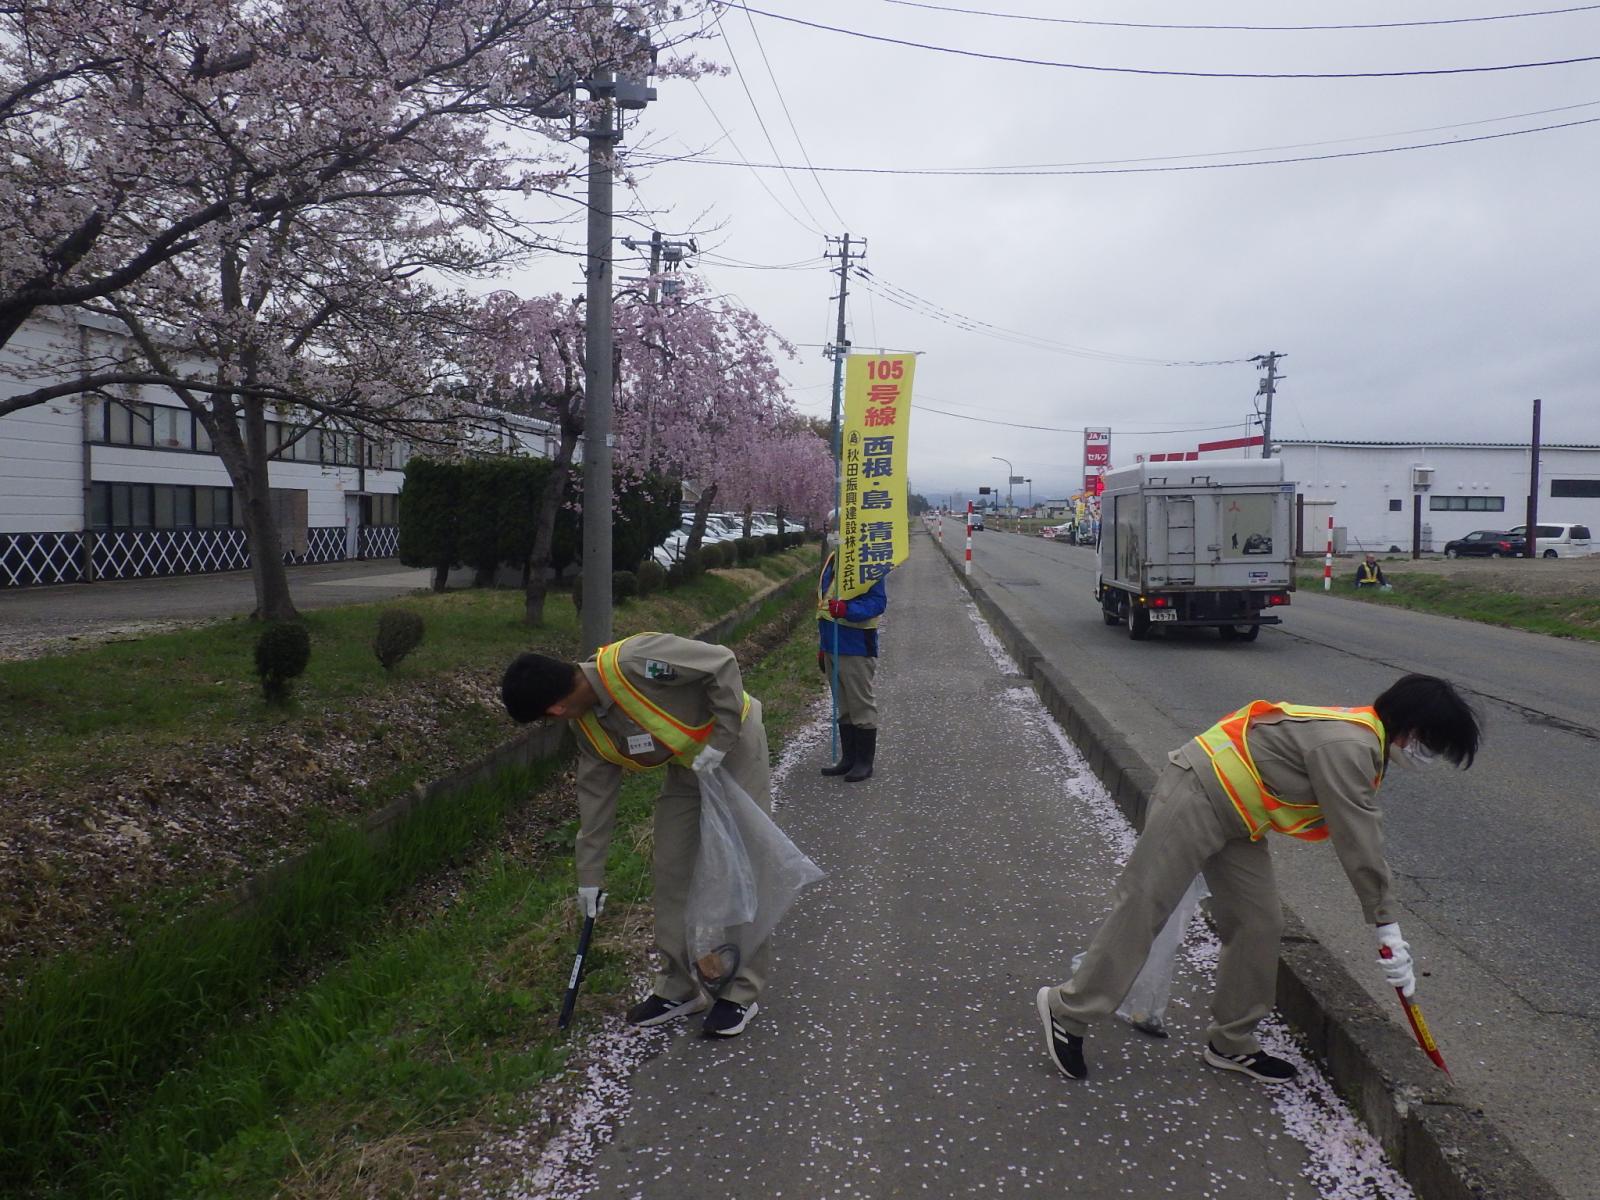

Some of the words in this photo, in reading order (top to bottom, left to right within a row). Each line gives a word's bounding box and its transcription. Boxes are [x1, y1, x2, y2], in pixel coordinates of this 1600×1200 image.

[1088, 432, 1099, 440] JA
[1087, 453, 1108, 461] セルフ
